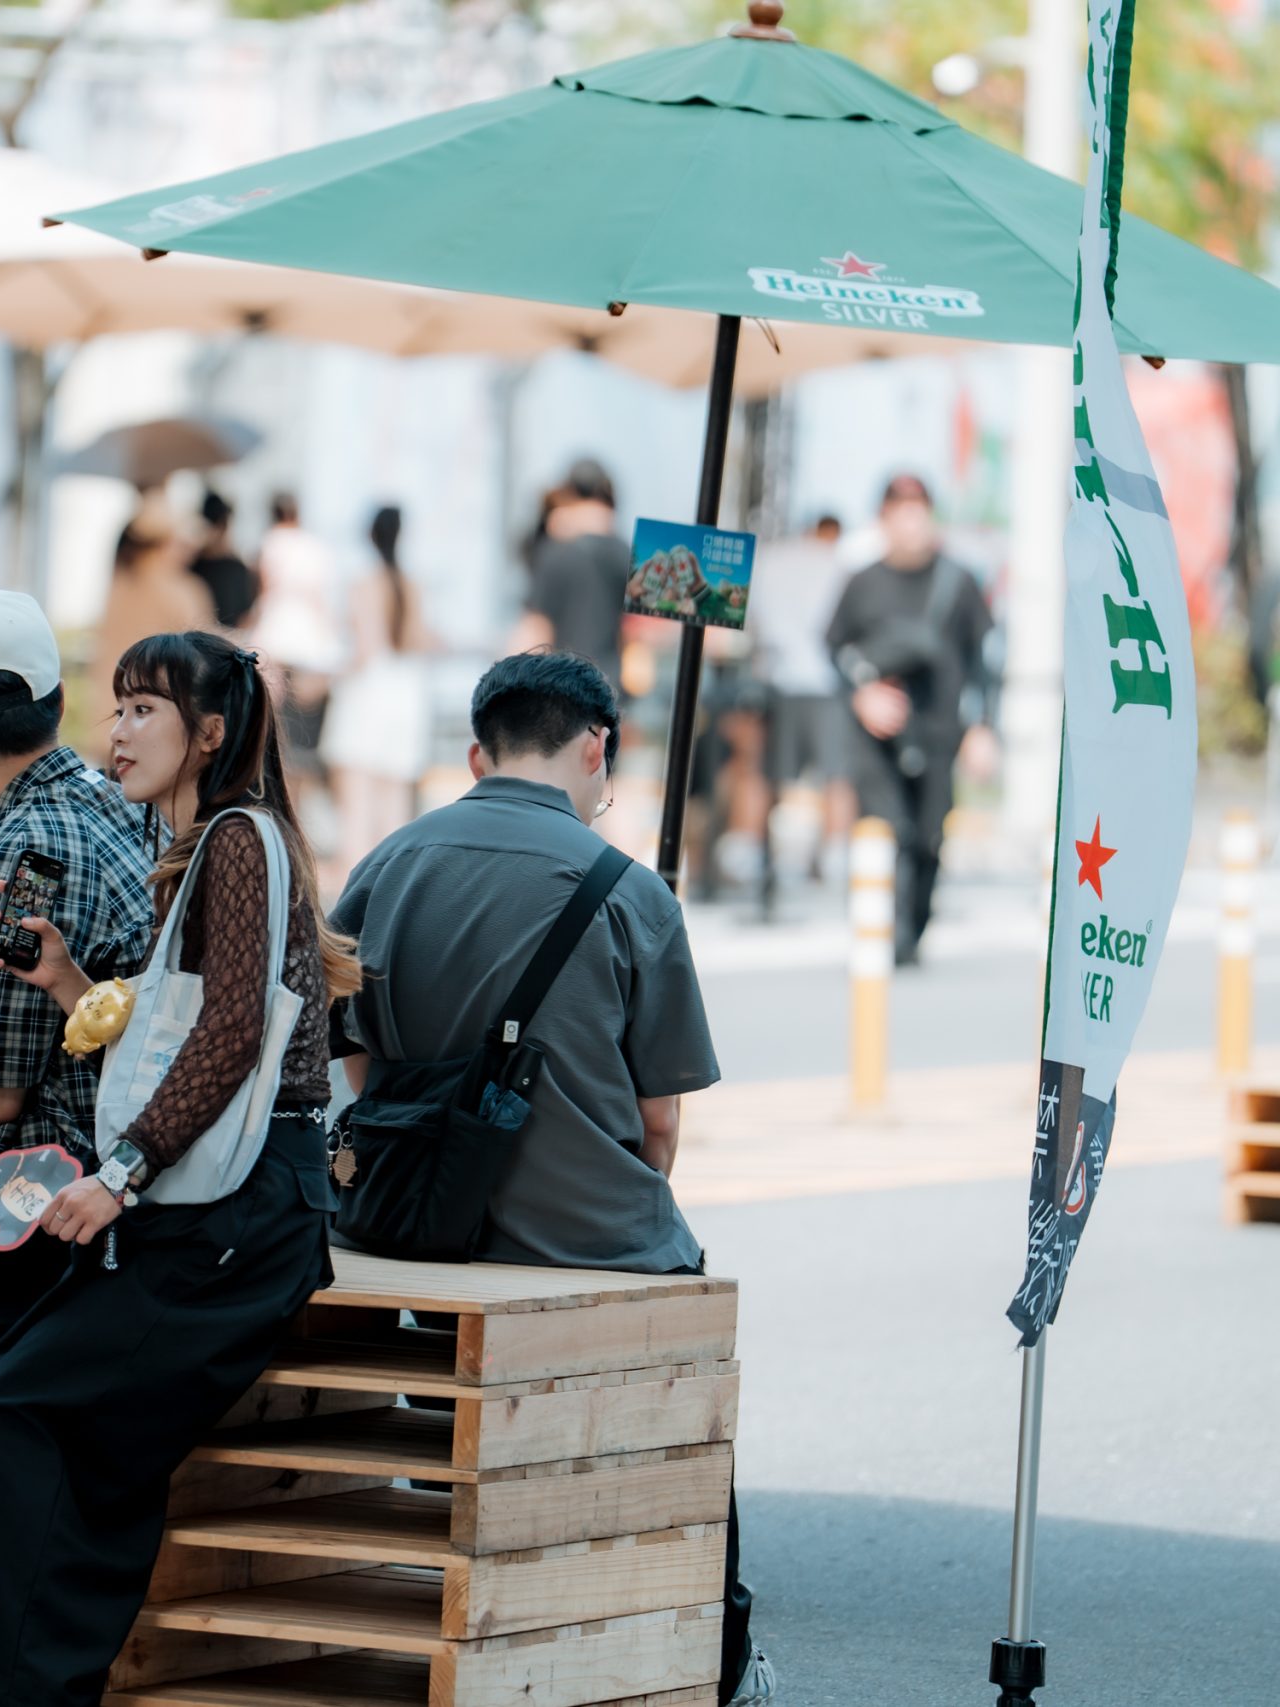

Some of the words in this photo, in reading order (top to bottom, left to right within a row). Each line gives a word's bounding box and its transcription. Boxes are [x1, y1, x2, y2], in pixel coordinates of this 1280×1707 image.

[764, 275, 968, 310] Heineken
[821, 301, 930, 329] SILVER
[1081, 914, 1147, 968] eken
